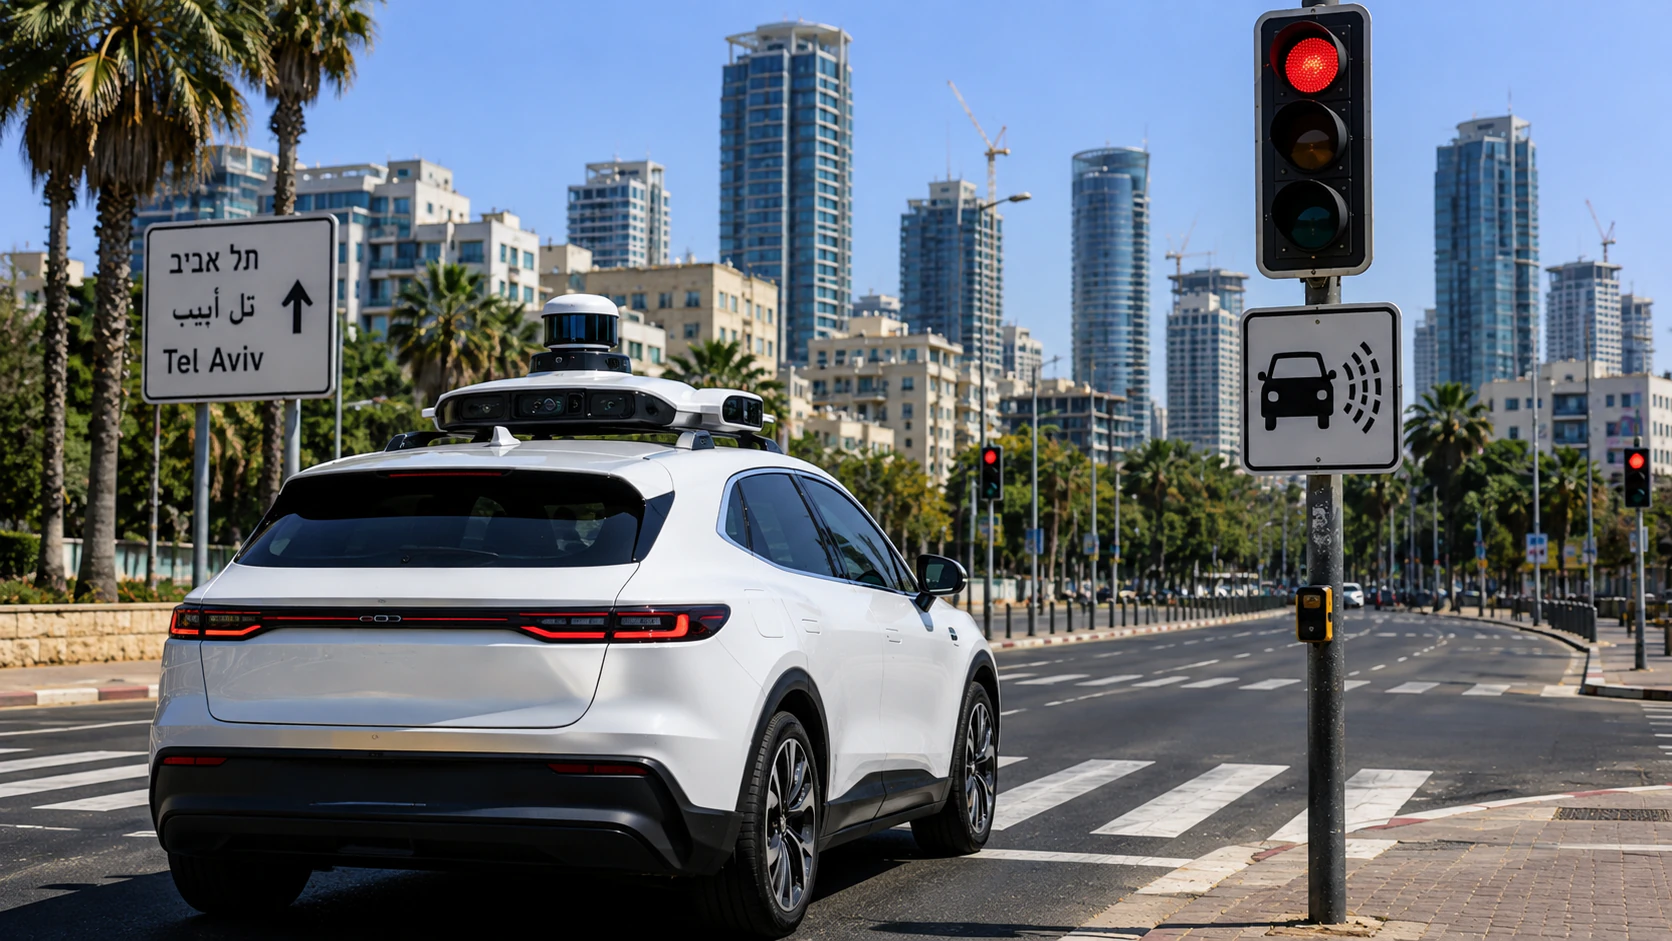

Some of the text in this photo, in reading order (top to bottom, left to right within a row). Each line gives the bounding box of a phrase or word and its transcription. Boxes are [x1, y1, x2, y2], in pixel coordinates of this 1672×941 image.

[169, 244, 258, 274] תל אביב
[229, 293, 255, 325] تل
[163, 345, 264, 374] Tel Aviv
